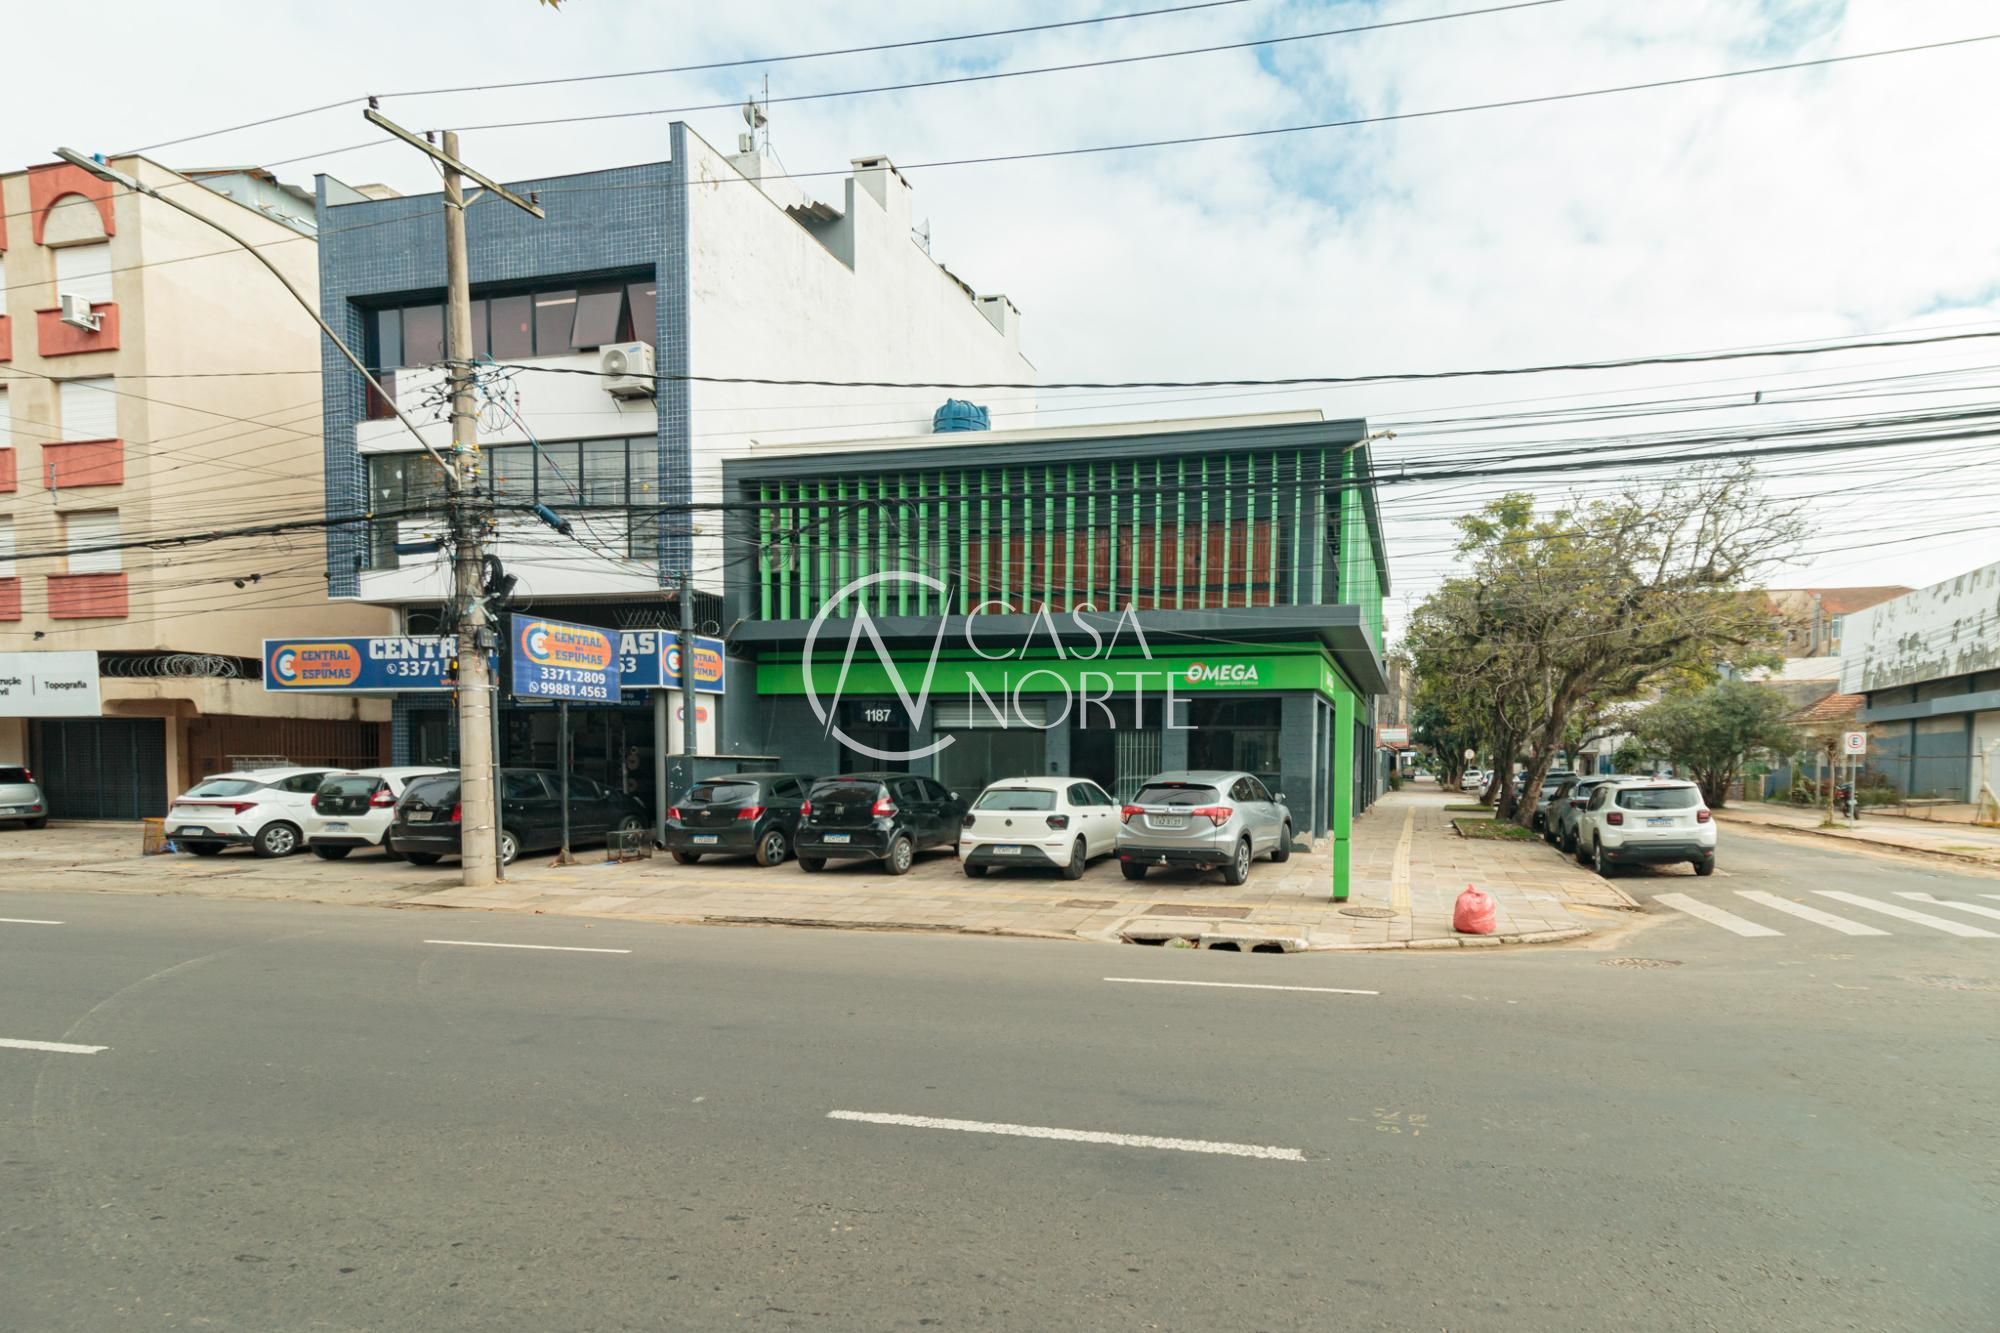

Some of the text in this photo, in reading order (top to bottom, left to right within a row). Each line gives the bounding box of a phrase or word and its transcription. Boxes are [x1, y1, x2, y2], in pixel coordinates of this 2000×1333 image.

[554, 632, 603, 648] CENTRAL
[619, 632, 656, 655] AS
[301, 650, 351, 661] CENTRAL
[369, 638, 458, 660] CENTR
[555, 650, 603, 665] ESPUMAS
[302, 668, 352, 680] ESPUMAS
[540, 666, 606, 684] 3371.2809
[1187, 663, 1259, 681] OMEGA
[44, 681, 87, 690] Topografia
[540, 682, 607, 698] 99881.4563
[864, 709, 892, 722] 1187
